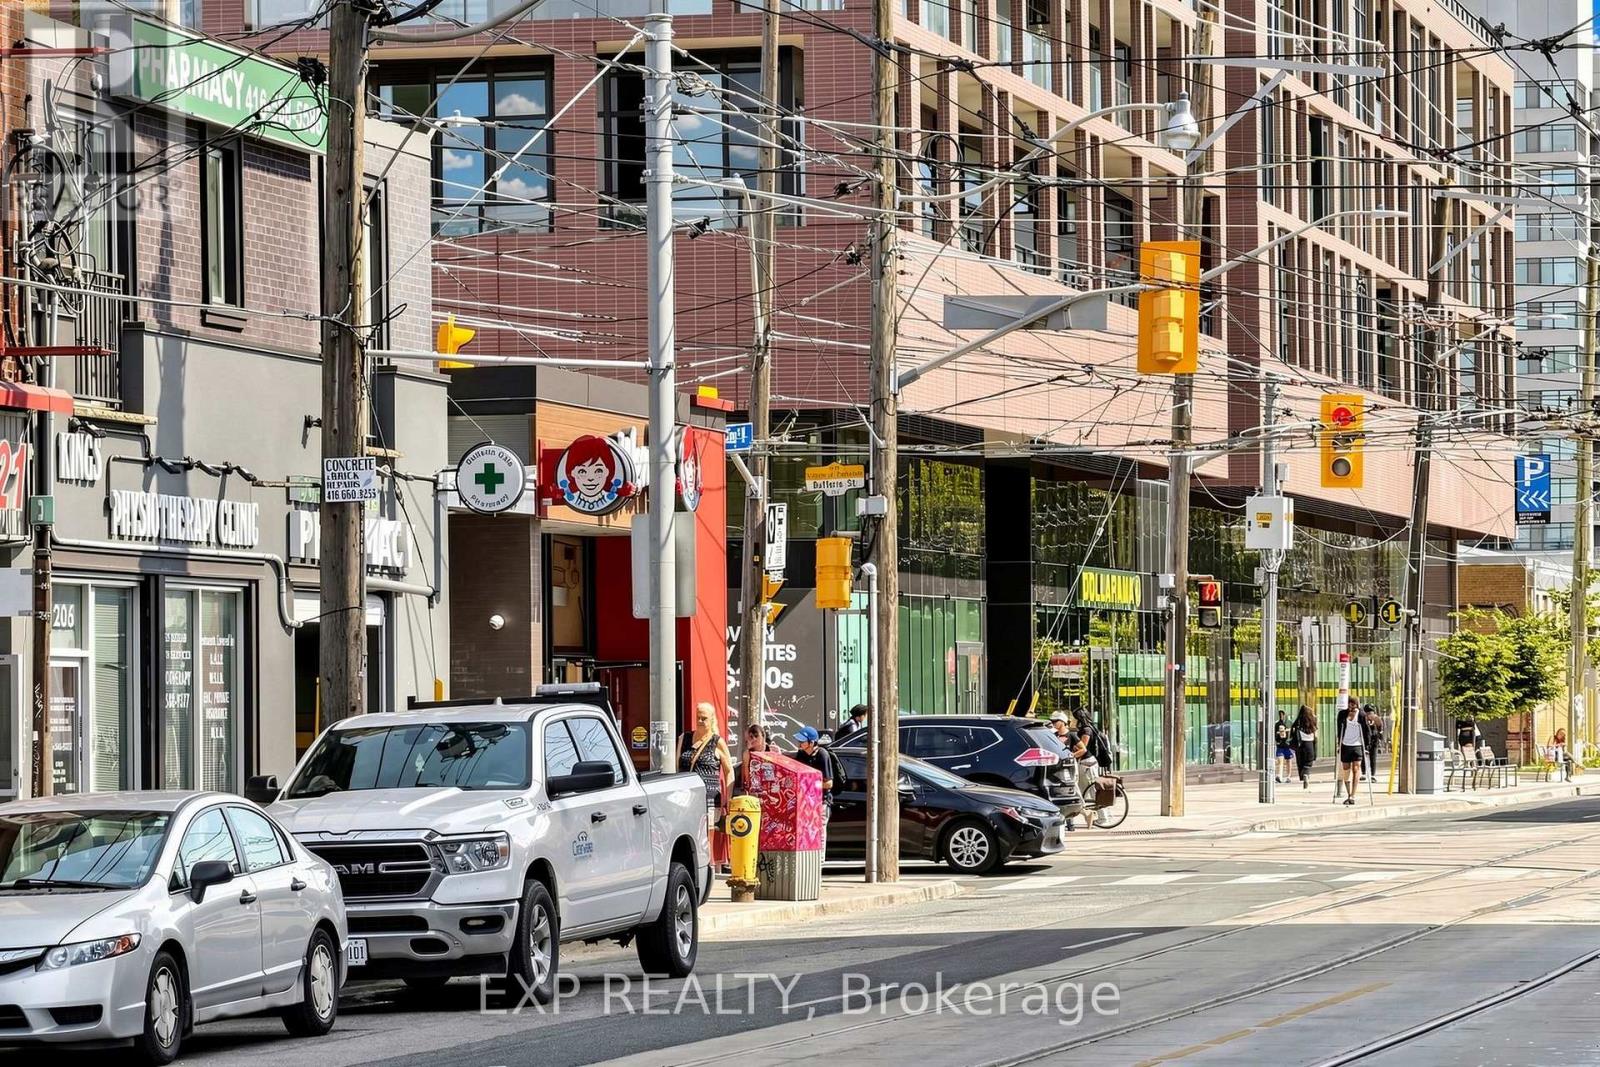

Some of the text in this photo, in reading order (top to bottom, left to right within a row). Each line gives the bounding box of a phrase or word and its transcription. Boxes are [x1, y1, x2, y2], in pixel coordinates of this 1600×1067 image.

[140, 39, 245, 111] PHARMACY
[59, 432, 102, 480] KINGS
[326, 458, 374, 471] CONCRETE
[331, 472, 359, 480] BRICK
[1525, 458, 1544, 486] P
[327, 481, 360, 489] REPAIRS
[847, 479, 856, 487] St
[111, 490, 259, 546] PHYSIOTHERAPY CLINIC
